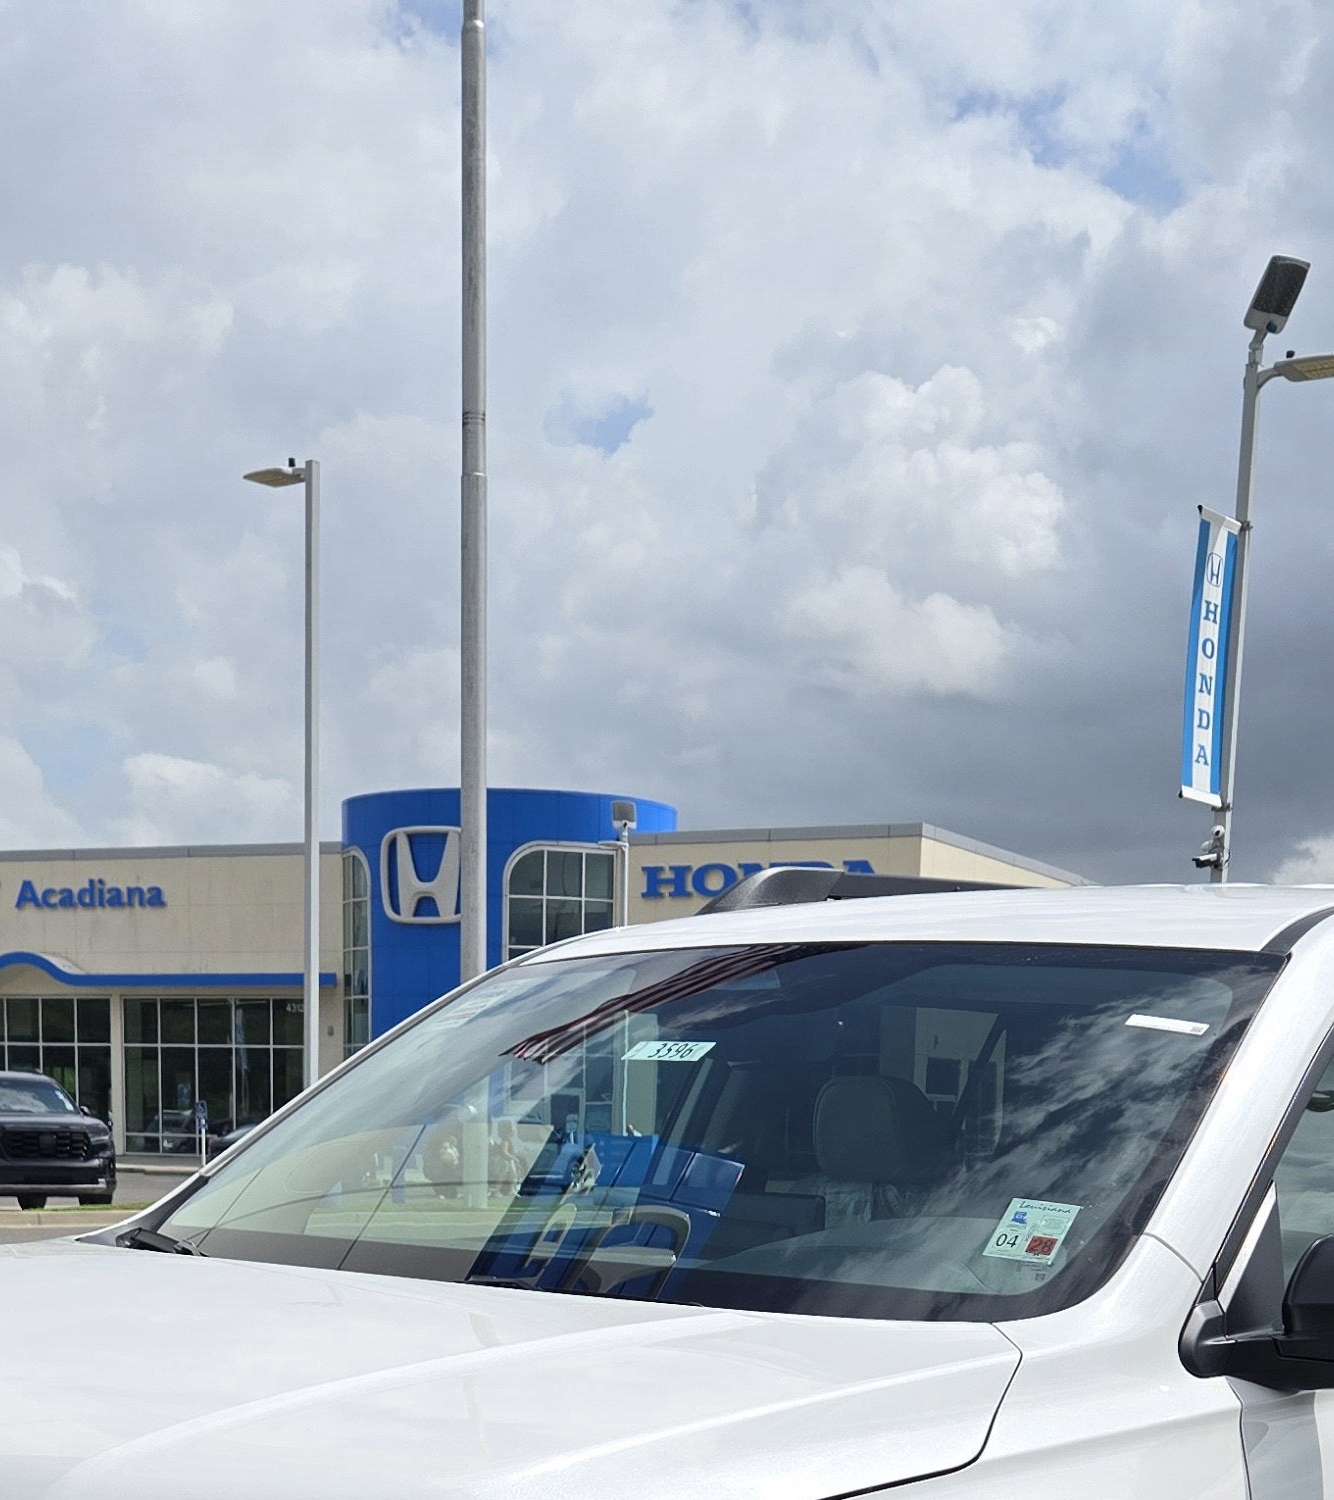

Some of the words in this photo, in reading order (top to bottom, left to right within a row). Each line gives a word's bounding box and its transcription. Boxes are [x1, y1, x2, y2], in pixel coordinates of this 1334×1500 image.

[1194, 601, 1219, 766] HONDA
[15, 878, 167, 909] Acadiana
[647, 1043, 699, 1059] 3596
[1019, 1200, 1072, 1214] Louisiana
[995, 1233, 1019, 1248] 04
